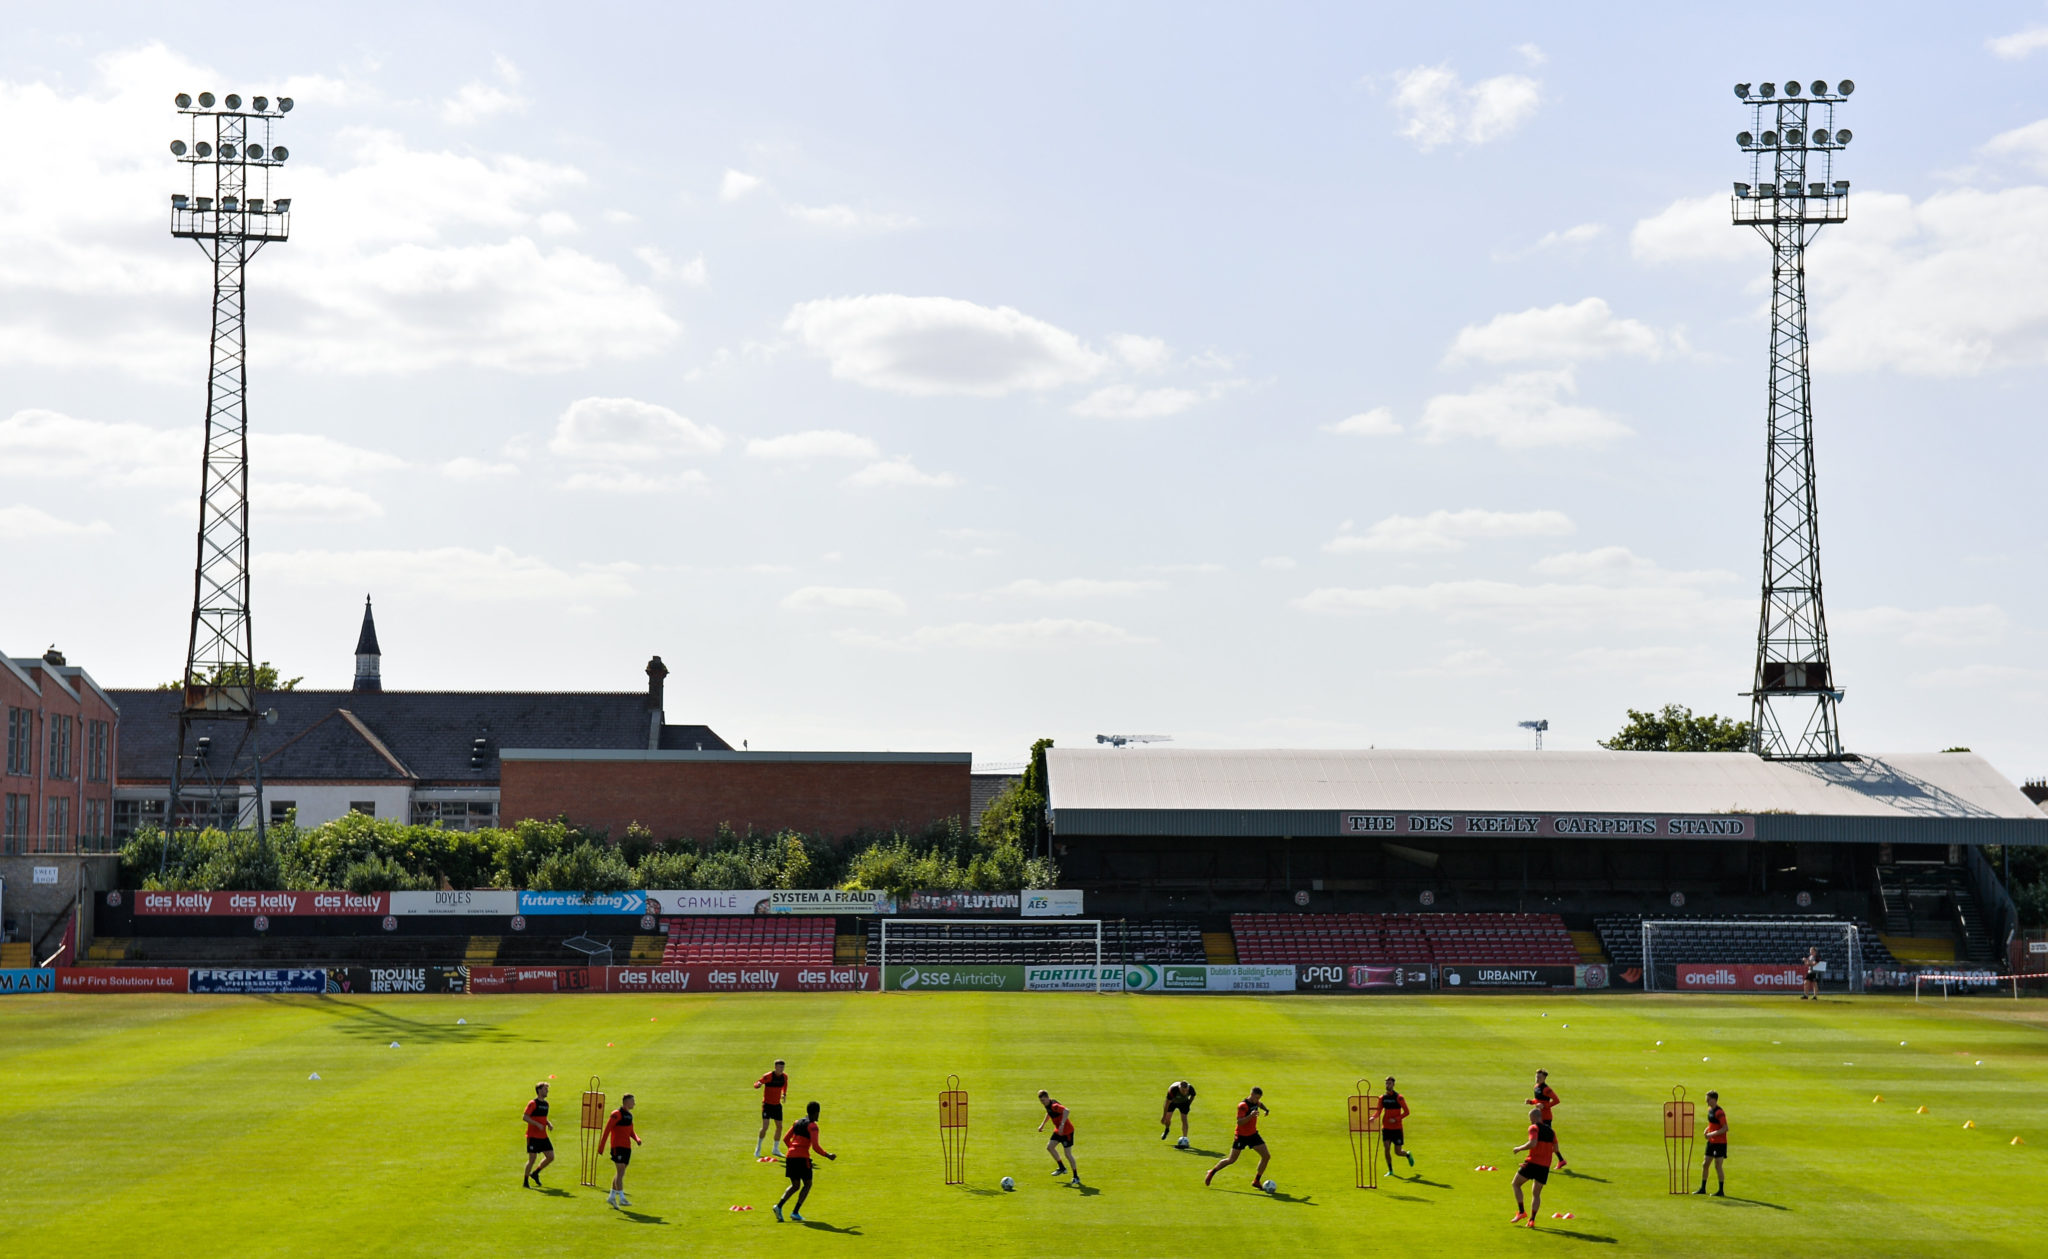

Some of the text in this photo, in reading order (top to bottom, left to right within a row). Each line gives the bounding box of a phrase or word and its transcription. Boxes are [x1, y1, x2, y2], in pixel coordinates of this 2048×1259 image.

[1349, 815, 1744, 836] THE DES KELLY CARPETS STAND
[145, 894, 212, 912] des kelly
[230, 894, 297, 912] des kelly
[314, 894, 381, 912] des kelly
[435, 892, 471, 904] DOYLE'S
[522, 894, 564, 906] future
[772, 893, 876, 903] SYSTEM A FRAUD
[1028, 900, 1048, 908] AES
[197, 970, 317, 980] FRAME FX
[370, 968, 426, 980] TROUBLE
[518, 970, 557, 980] BOHEMIAN
[1210, 968, 1292, 977] Dublin's Building Experts
[1478, 970, 1538, 980] URBANITY
[62, 976, 174, 986] M&P Fire Solutions Ltd.
[558, 969, 590, 989] RED
[619, 970, 690, 989] des kelly
[708, 970, 779, 989] des kelly
[798, 970, 868, 989] des kelly
[921, 972, 1006, 987] sse Airtricity
[370, 980, 426, 992] BREWING
